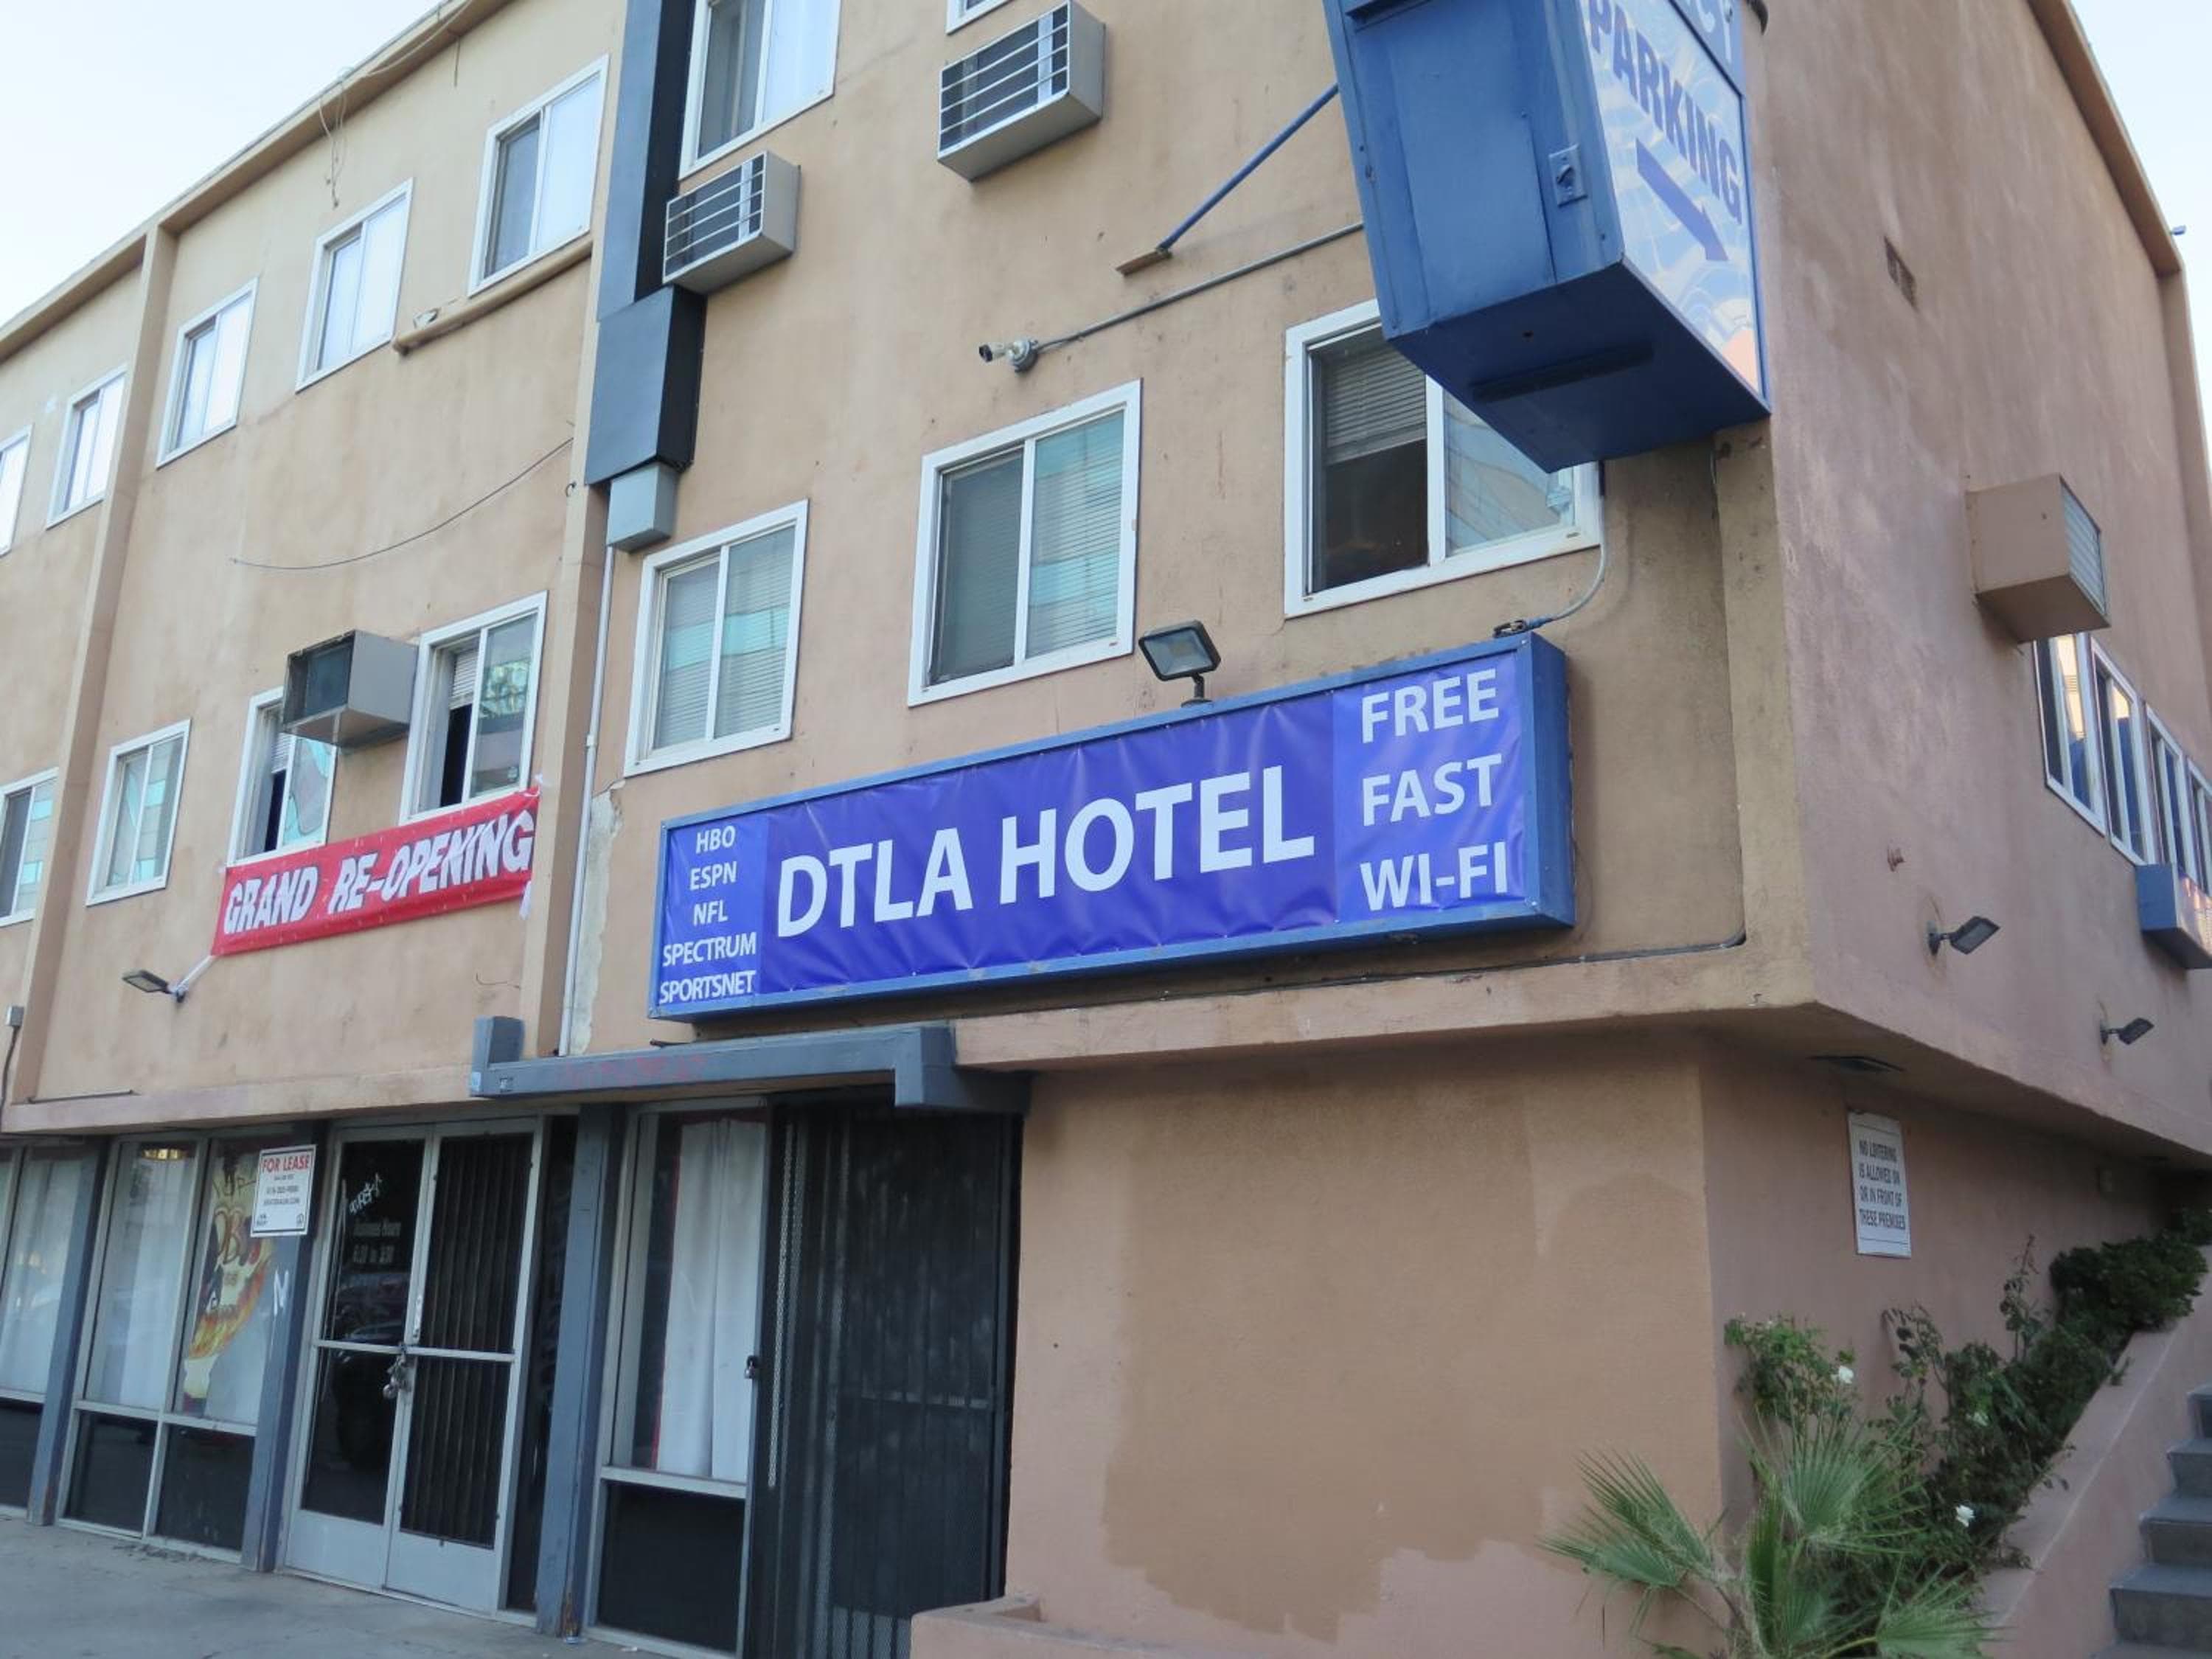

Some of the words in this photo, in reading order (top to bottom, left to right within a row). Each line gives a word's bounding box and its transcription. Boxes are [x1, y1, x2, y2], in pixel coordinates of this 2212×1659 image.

[1589, 0, 1743, 224] PARKING
[1362, 668, 1499, 743] FREE
[1363, 753, 1502, 827] FAST
[696, 825, 736, 854] HBO
[778, 827, 974, 938] DTLA
[999, 765, 1315, 905] HOTEL
[224, 866, 318, 934] GRAND
[327, 810, 536, 915] RE-OPENING
[690, 860, 737, 891] ESPN
[1360, 841, 1508, 911] WI-FI
[693, 900, 728, 926] NFL
[662, 931, 757, 967] SPECTRUM
[659, 970, 757, 1004] SPORTSNET
[262, 1156, 280, 1173] FOR
[283, 1155, 309, 1171] LEASE
[1859, 1141, 1868, 1156] NO
[1869, 1144, 1897, 1162] LOITERING
[1859, 1163, 1865, 1179] IS
[1865, 1164, 1891, 1183] ALLOWED
[1860, 1185, 1868, 1203] OR
[1869, 1187, 1877, 1203] IN
[1877, 1189, 1894, 1206] FRONT
[1895, 1192, 1902, 1207] OF
[1859, 1208, 1877, 1227] THESE
[1878, 1211, 1906, 1230] PREMISES
